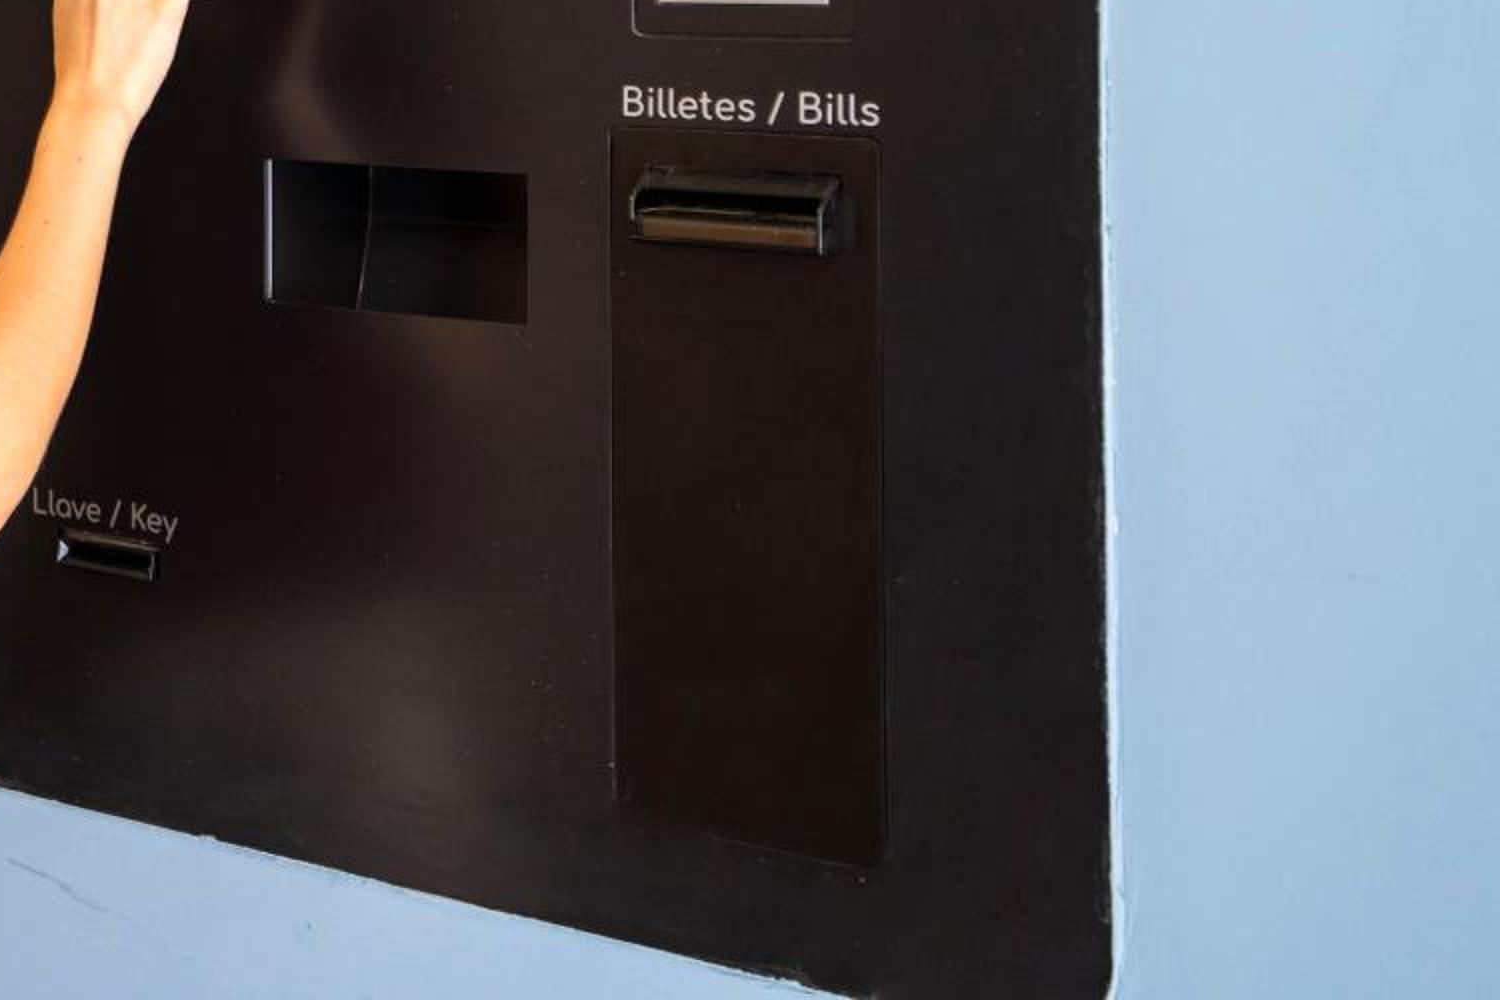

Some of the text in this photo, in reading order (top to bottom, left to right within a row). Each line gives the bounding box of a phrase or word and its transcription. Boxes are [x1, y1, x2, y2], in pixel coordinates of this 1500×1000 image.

[621, 84, 881, 127] Billetes / Bills
[32, 487, 102, 523] Llave
[131, 502, 179, 544] Key
